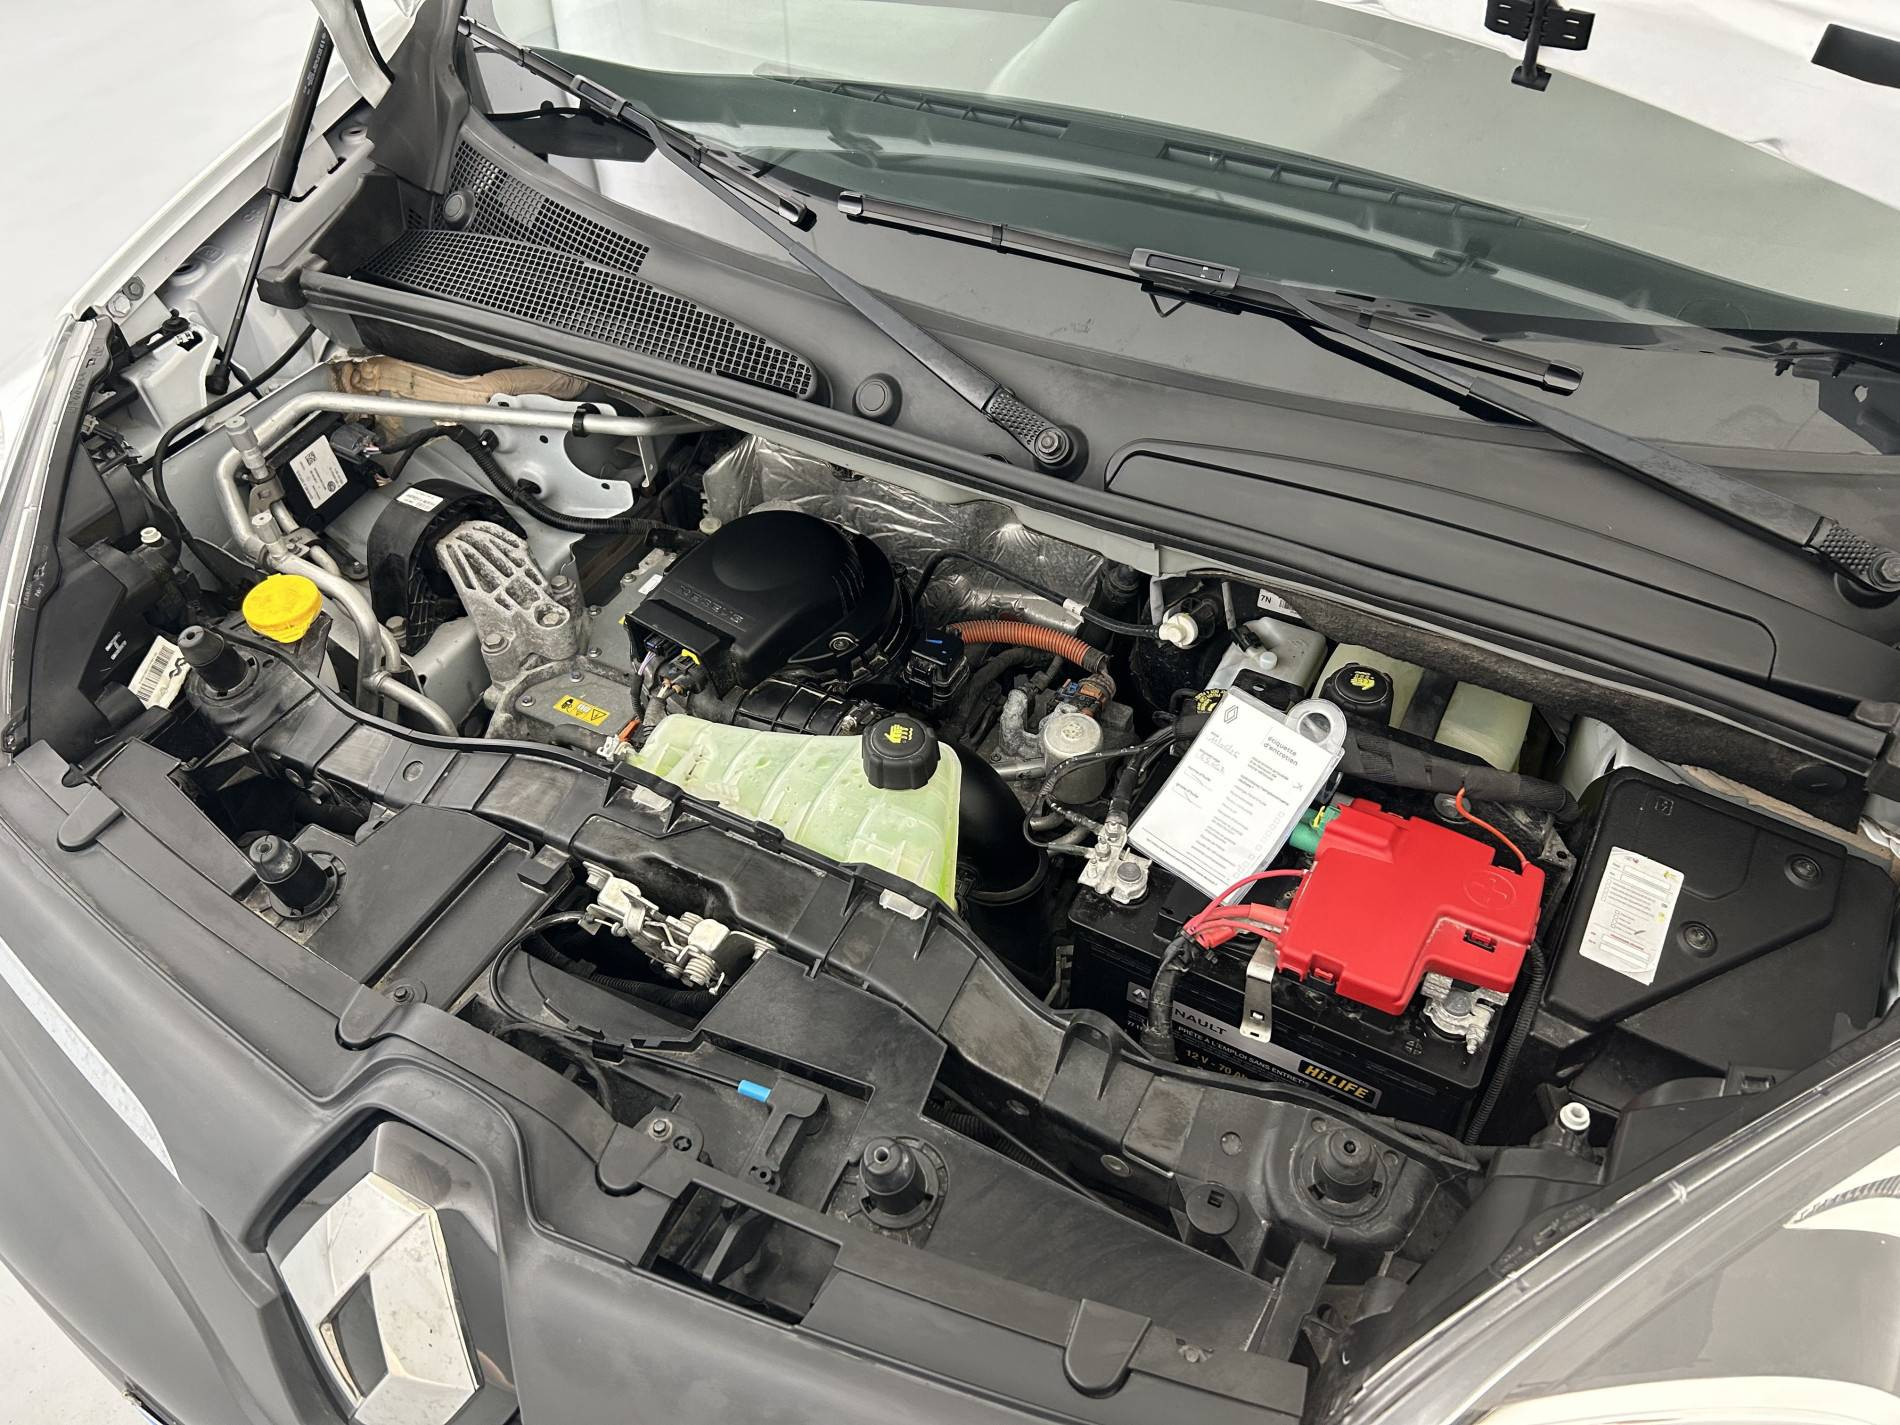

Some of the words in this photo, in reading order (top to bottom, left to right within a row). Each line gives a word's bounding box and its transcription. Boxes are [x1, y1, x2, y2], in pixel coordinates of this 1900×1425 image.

[1260, 594, 1271, 604] 7N
[1174, 1008, 1227, 1035] NAULT
[1185, 1049, 1198, 1060] 12
[1304, 1064, 1369, 1099] Hi-LIFE
